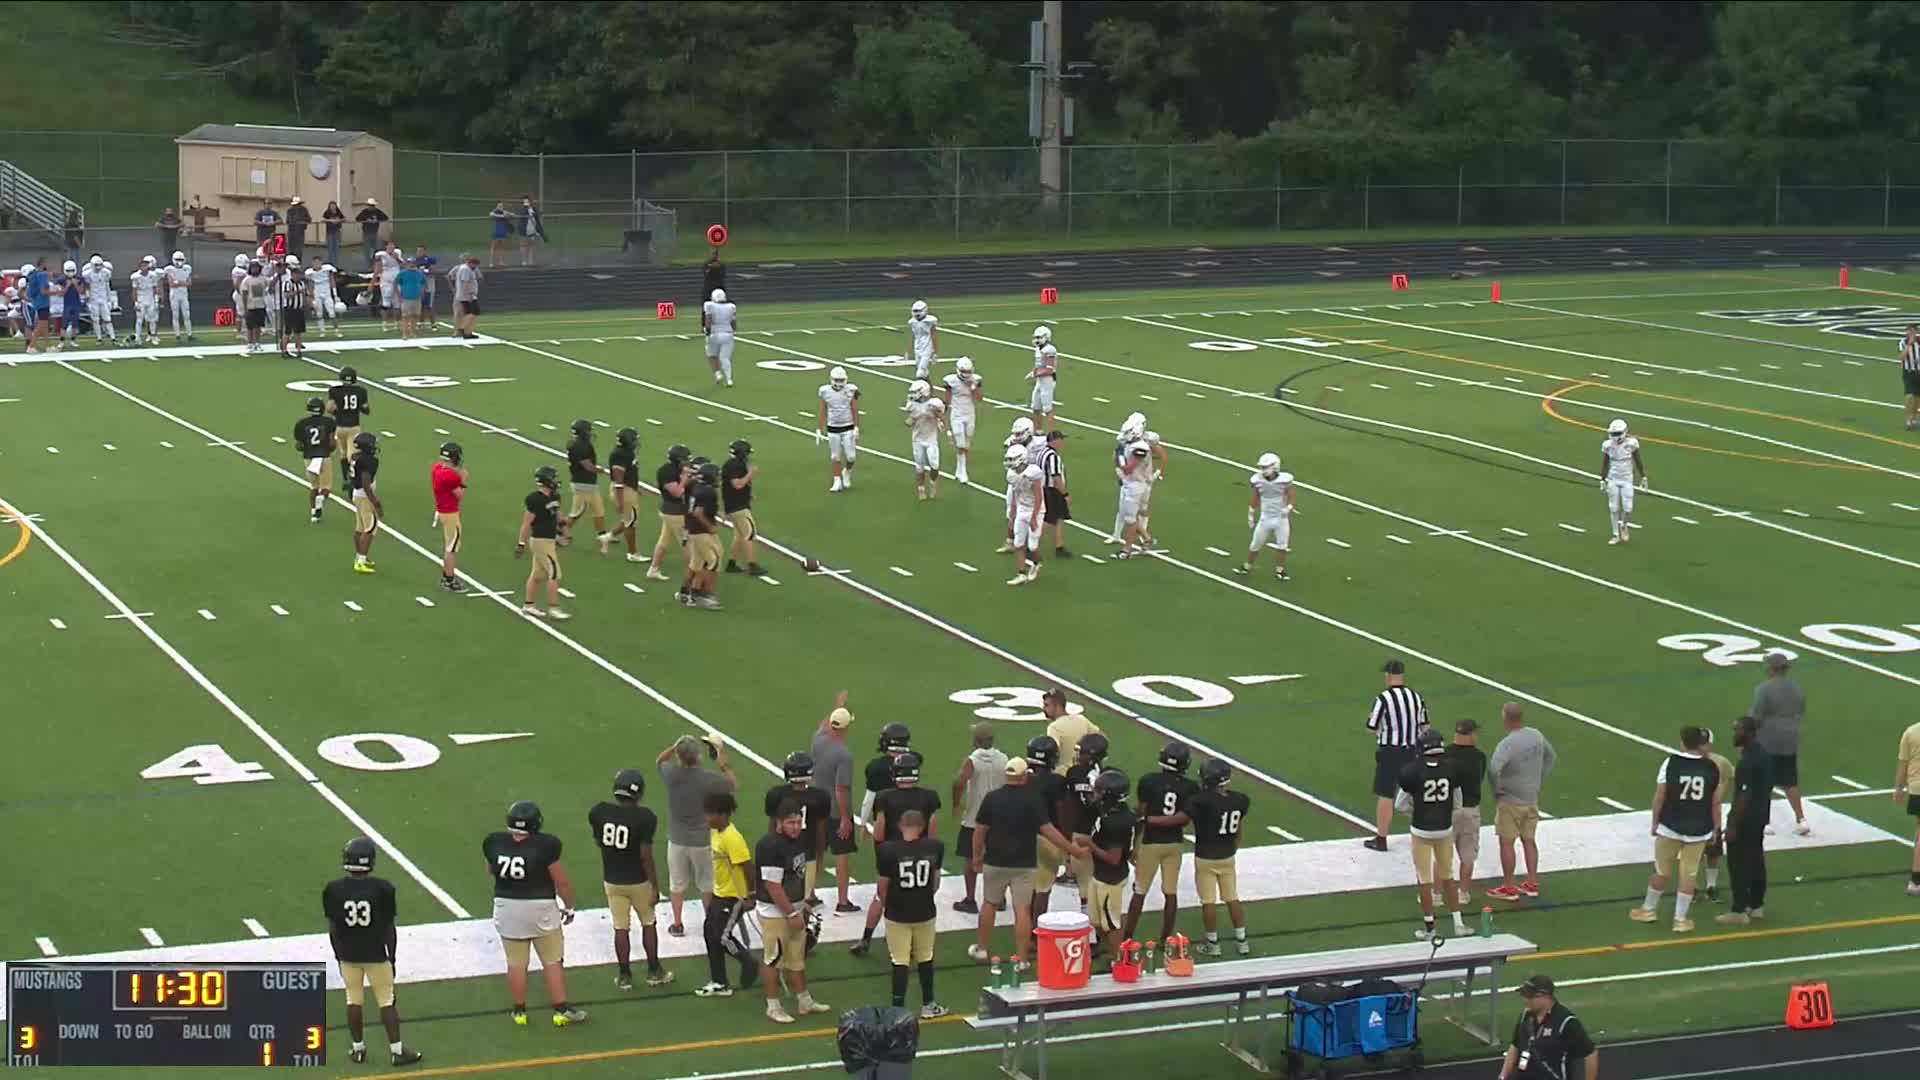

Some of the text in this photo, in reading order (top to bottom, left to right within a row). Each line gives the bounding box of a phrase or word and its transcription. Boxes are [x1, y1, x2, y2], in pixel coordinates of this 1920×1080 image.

[275, 235, 286, 254] 2
[218, 311, 233, 325] 30
[659, 304, 674, 317] 20
[343, 395, 358, 410] 19
[310, 428, 321, 445] 2
[1423, 777, 1450, 802] 23
[1679, 775, 1705, 801] 79
[1162, 791, 1178, 816] 9
[1218, 810, 1242, 835] 18
[602, 822, 630, 850] 80
[497, 855, 526, 880] 76
[899, 859, 931, 889] 50
[343, 900, 372, 927] 33
[1066, 940, 1083, 958] G
[1798, 990, 1829, 1025] 30
